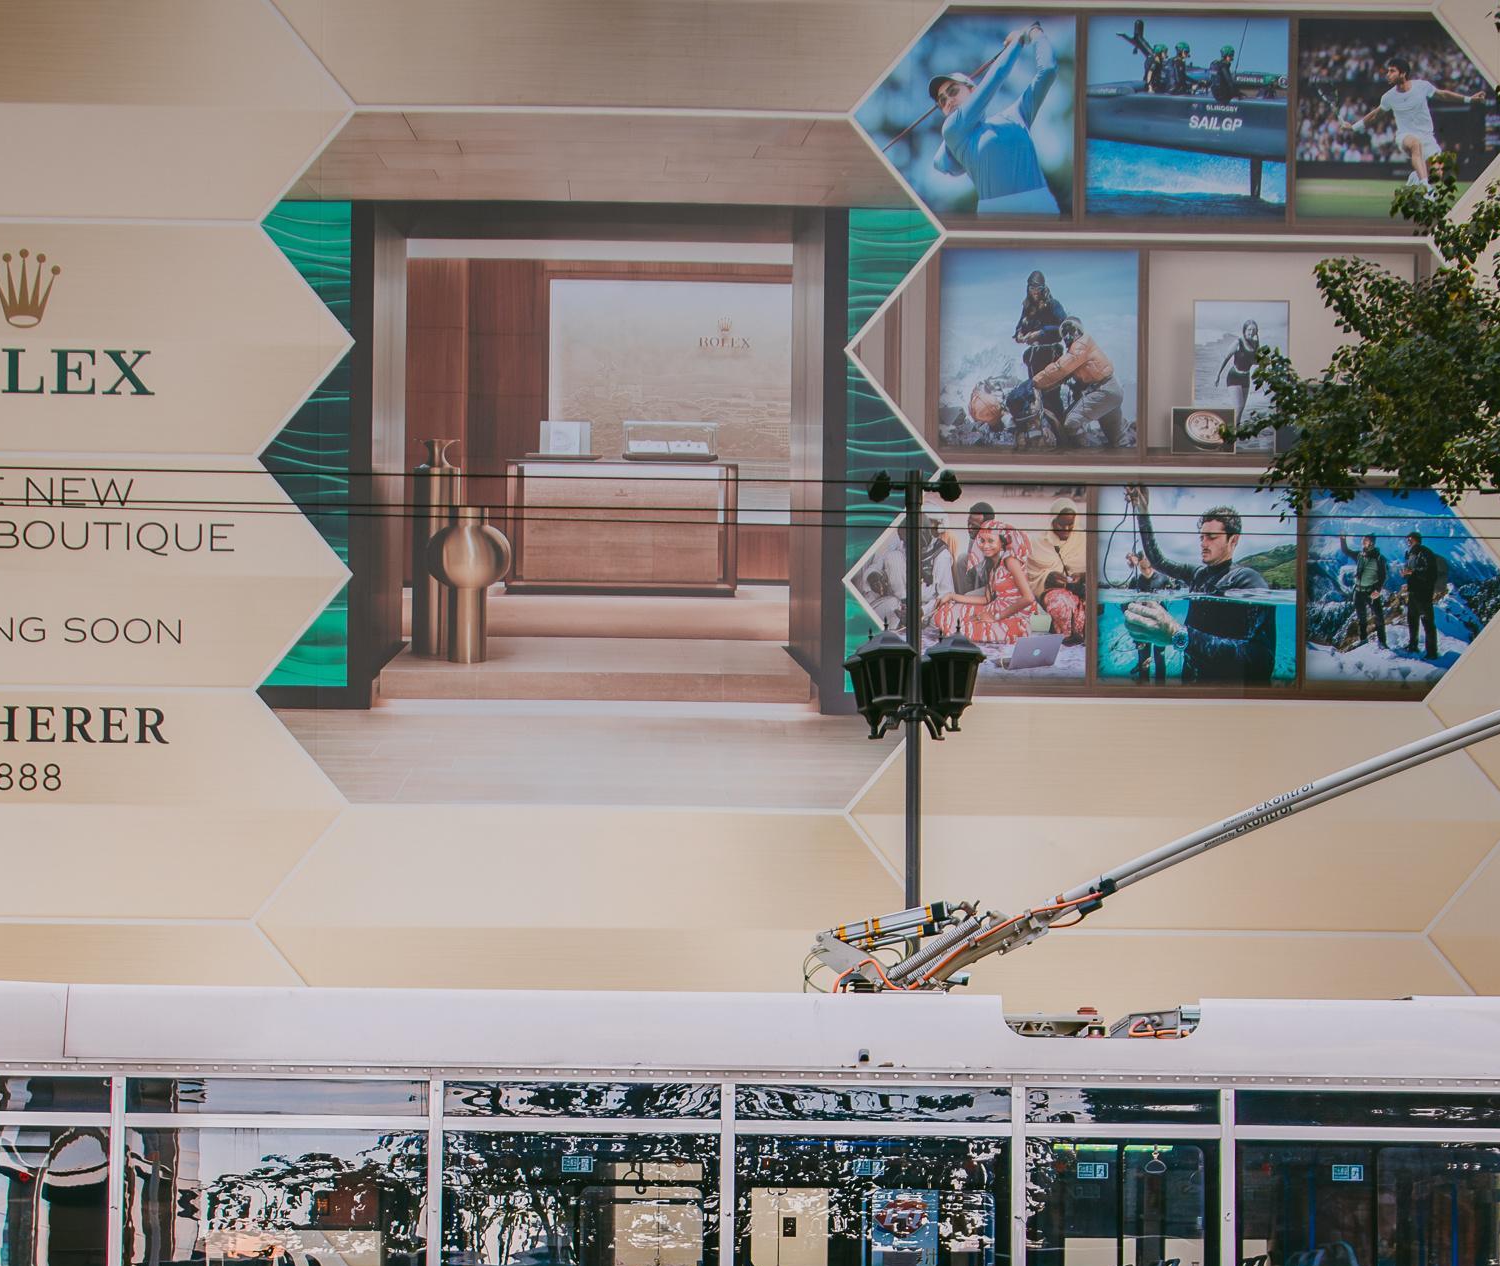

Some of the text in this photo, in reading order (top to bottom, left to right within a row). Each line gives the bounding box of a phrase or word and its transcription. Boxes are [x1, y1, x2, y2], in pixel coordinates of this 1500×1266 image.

[699, 336, 751, 350] ROLEX
[26, 477, 134, 507] NEW
[63, 617, 182, 644] SOON
